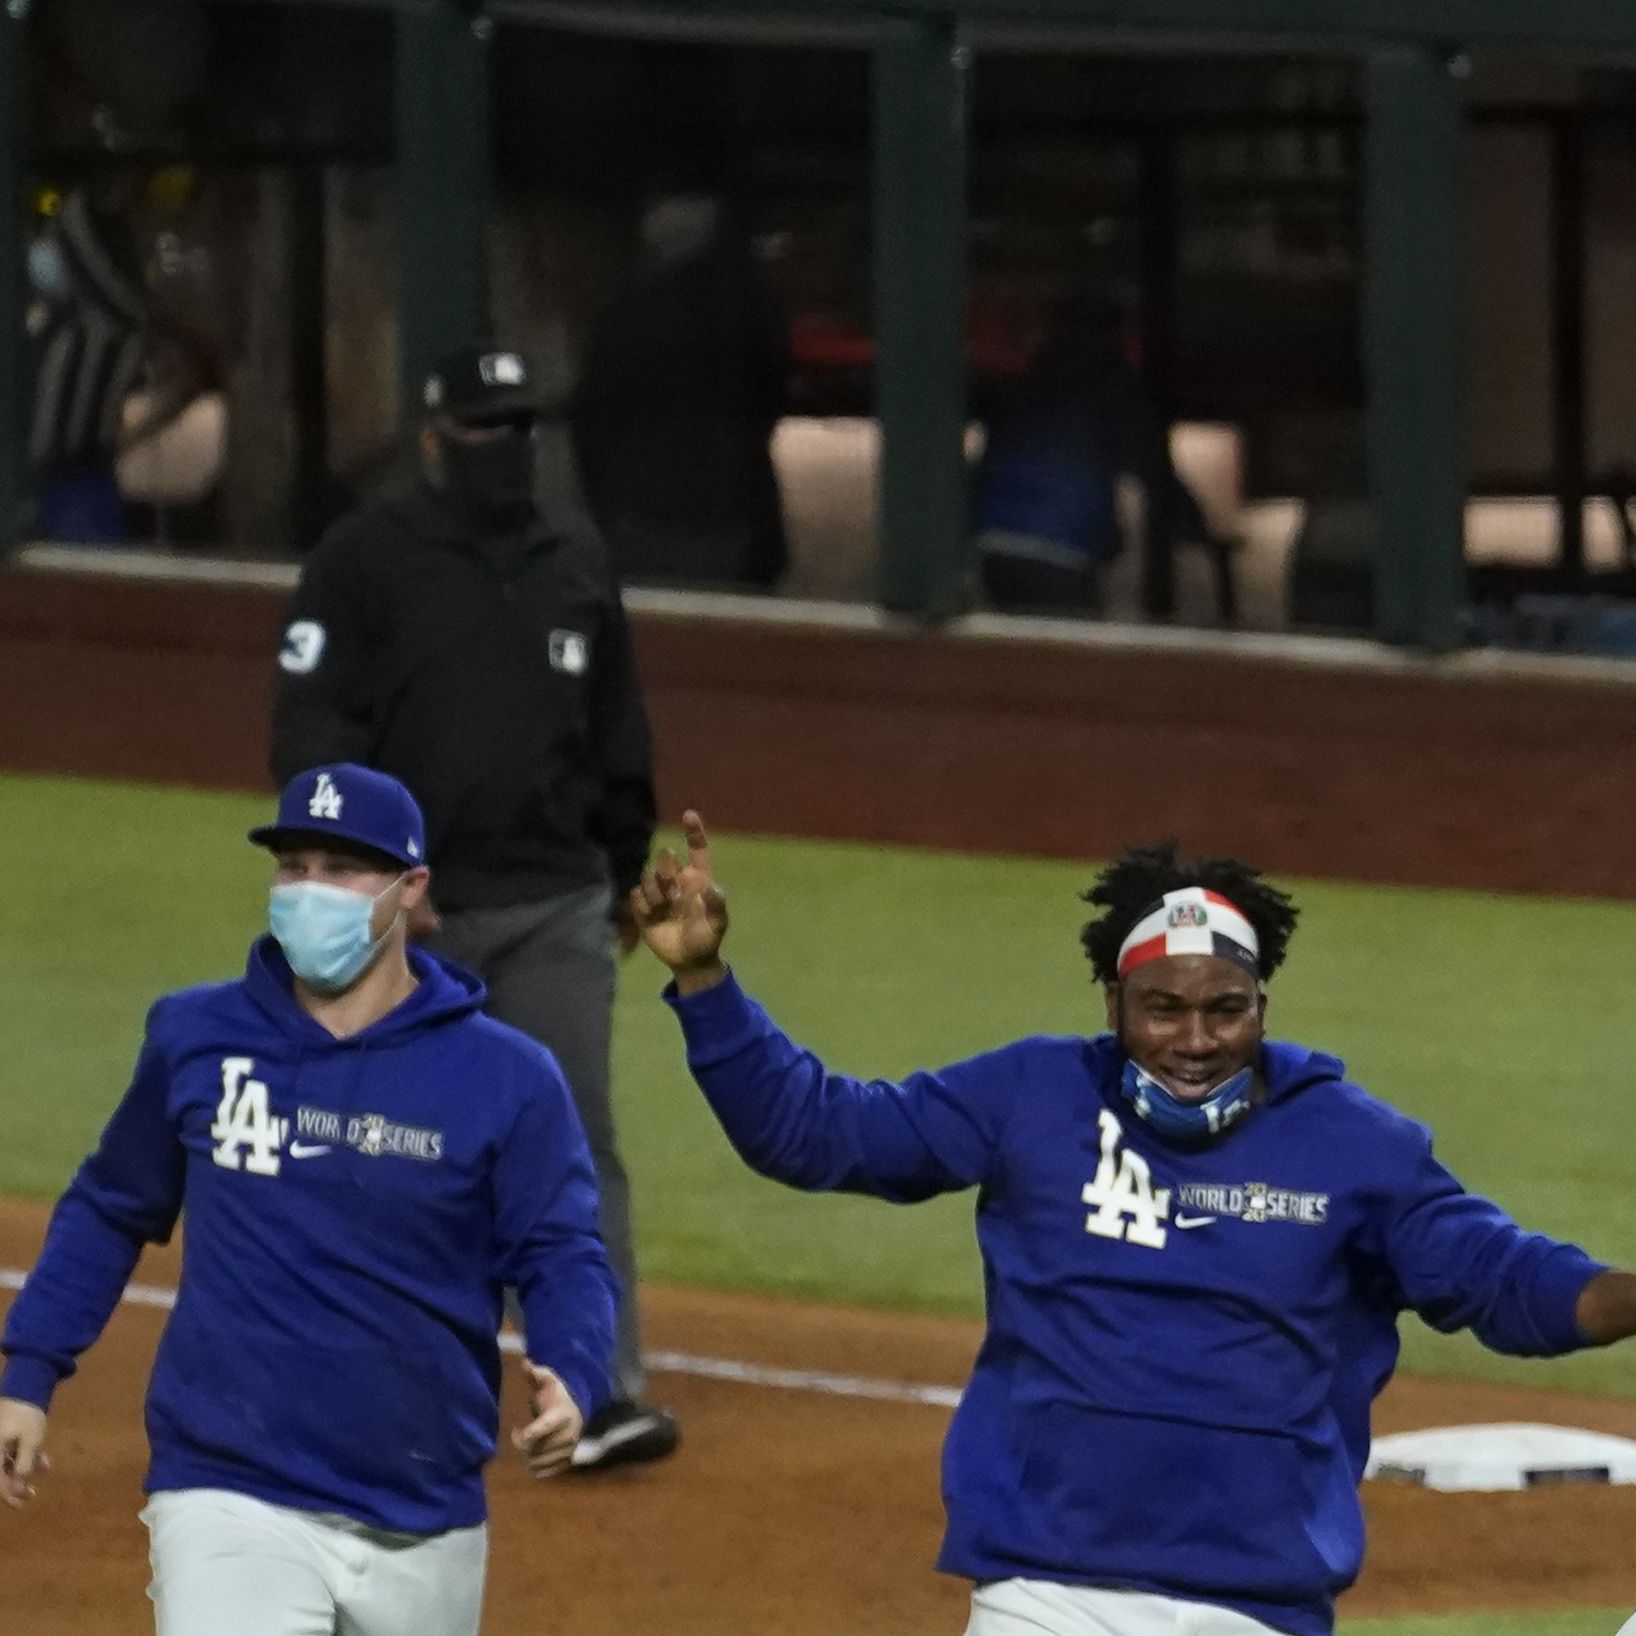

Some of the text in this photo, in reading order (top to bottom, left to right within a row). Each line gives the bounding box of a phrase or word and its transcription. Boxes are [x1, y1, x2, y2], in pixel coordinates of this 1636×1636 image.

[278, 619, 326, 675] 3
[309, 772, 342, 820] LA
[211, 1056, 288, 1178] LA
[297, 1106, 361, 1145] WORD
[384, 1122, 444, 1162] SERIES
[1081, 1107, 1172, 1250] LA
[1178, 1183, 1244, 1217] WORLD
[1265, 1189, 1331, 1227] SERIES
